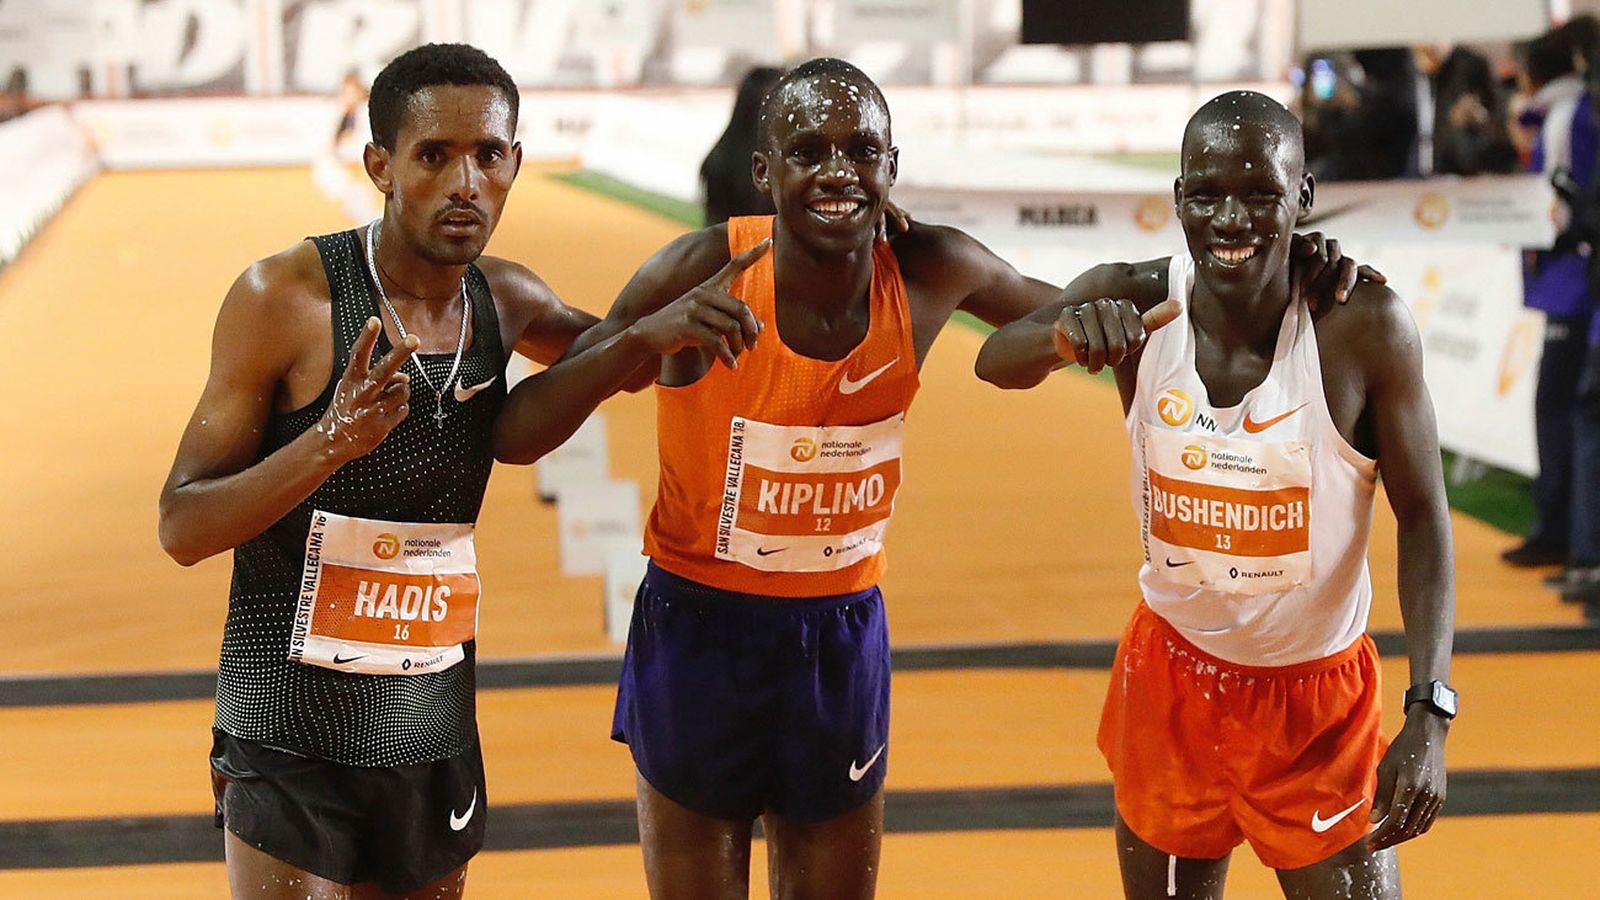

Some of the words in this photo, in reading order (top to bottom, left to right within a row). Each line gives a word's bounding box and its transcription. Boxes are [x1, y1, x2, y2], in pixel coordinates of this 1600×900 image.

[1196, 413, 1218, 432] NN
[821, 440, 863, 449] nationale
[727, 436, 745, 488] VALLECANA
[1211, 452, 1253, 464] nationale
[1211, 461, 1267, 475] nederlanden
[757, 473, 885, 515] KIPLIMO
[718, 490, 737, 536] SILVESTRE
[1152, 485, 1303, 532] BUSHENDICH
[814, 518, 831, 532] 12
[404, 538, 441, 548] nationale
[717, 537, 730, 554] SAN
[1215, 534, 1231, 550] 13
[403, 548, 450, 558] nederlanden
[302, 532, 324, 593] VALLECANA
[1241, 569, 1284, 579] RENAULT
[354, 581, 451, 622] HADIS
[292, 594, 314, 647] SILVESTRE
[393, 624, 410, 640] 16
